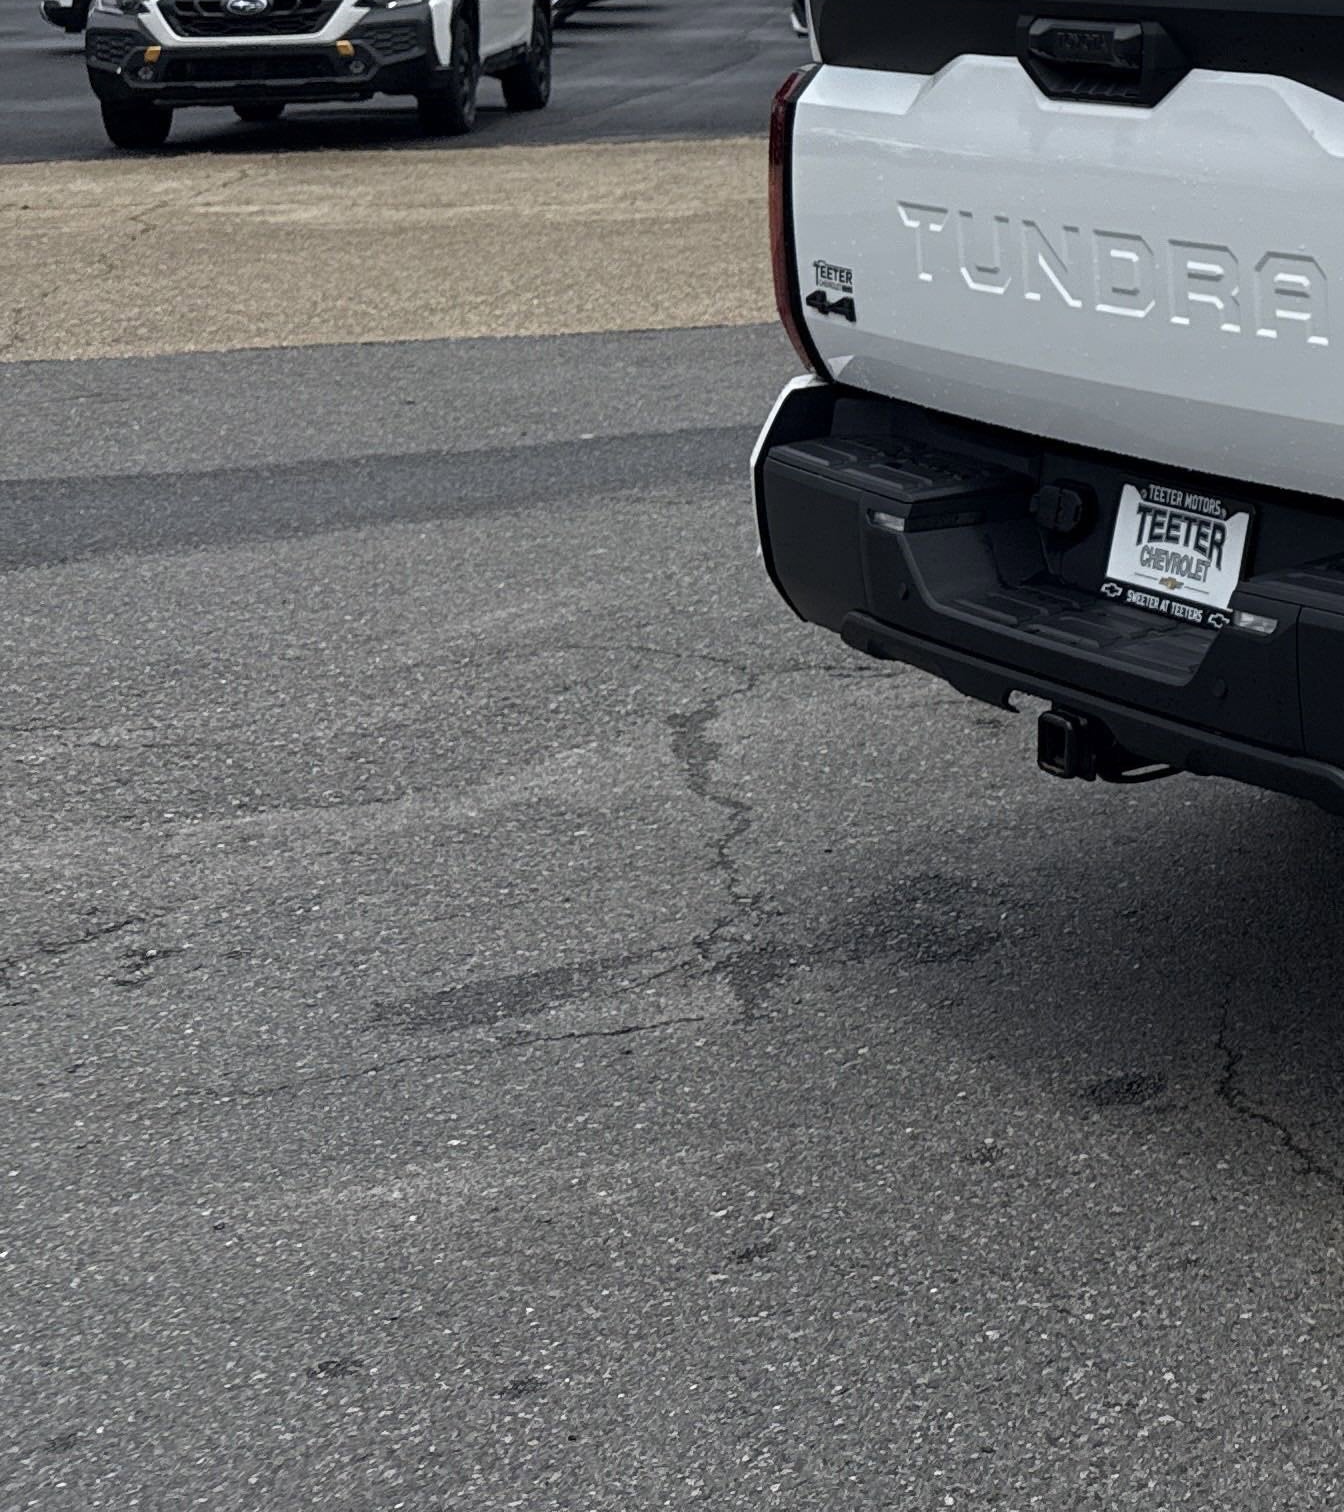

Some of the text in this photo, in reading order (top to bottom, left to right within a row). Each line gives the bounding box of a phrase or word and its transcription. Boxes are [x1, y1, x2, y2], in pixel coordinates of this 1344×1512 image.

[813, 259, 853, 286] TEETER
[897, 200, 1329, 346] TUNDRA
[1149, 484, 1222, 515] TEETER MOTORS
[1136, 502, 1227, 571] TEETER
[1140, 544, 1211, 583] CHEVROLET
[1126, 589, 1161, 611] SWEETER
[1159, 599, 1170, 613] AT
